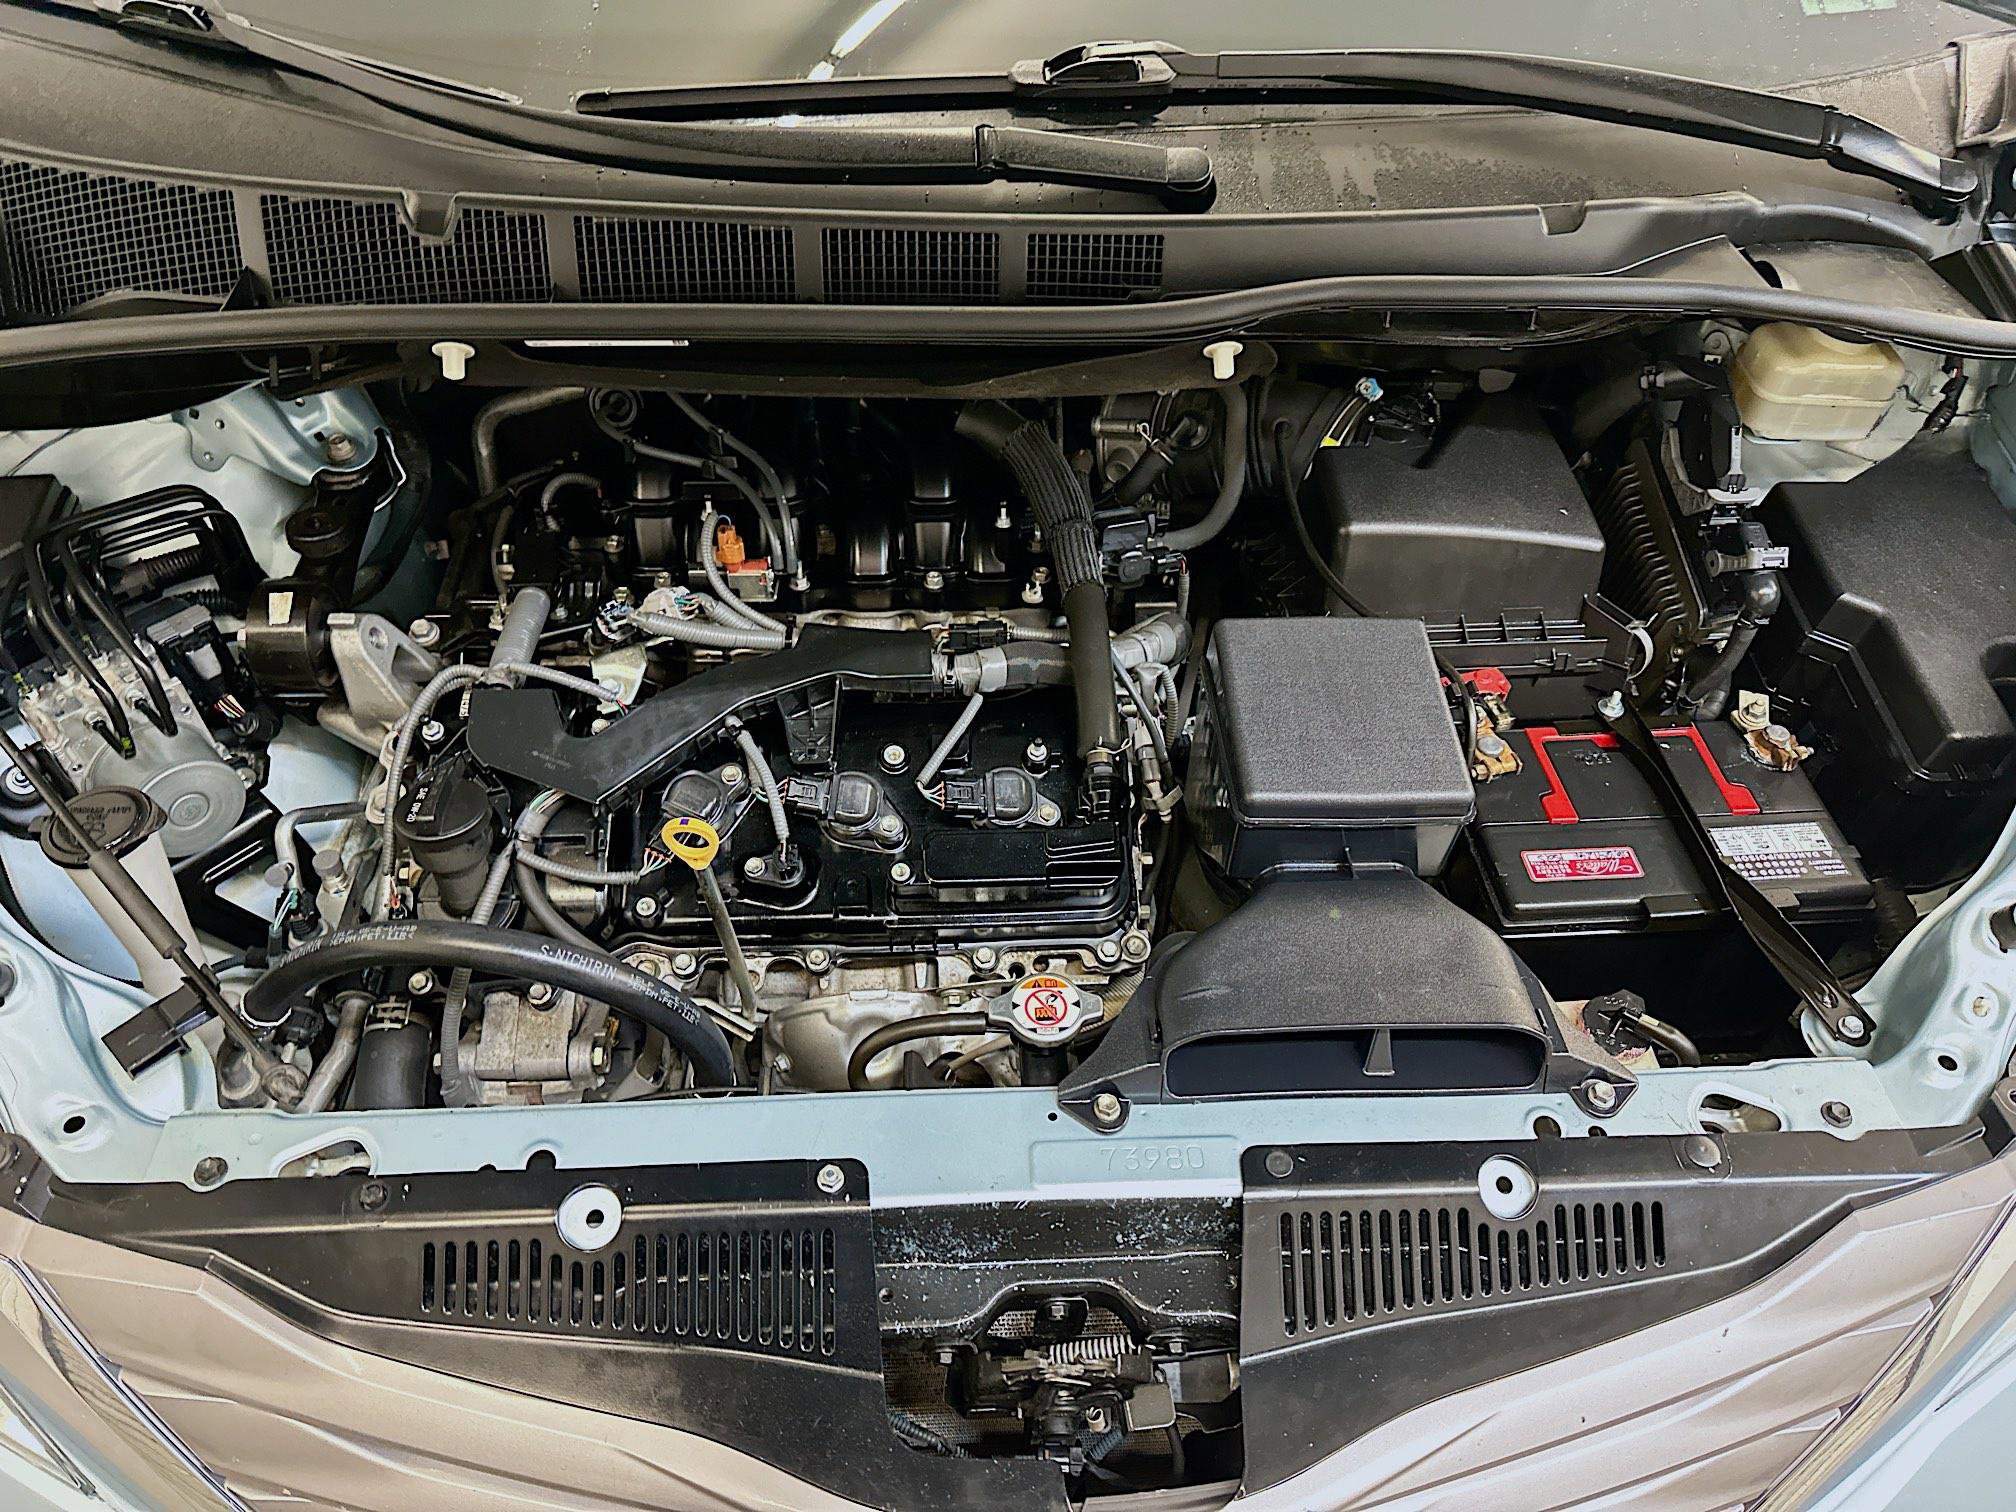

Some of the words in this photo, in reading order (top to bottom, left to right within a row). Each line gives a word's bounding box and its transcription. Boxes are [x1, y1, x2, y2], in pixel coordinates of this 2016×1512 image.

[416, 787, 428, 800] SAE
[406, 802, 421, 822] 0W-20
[1100, 1146, 1205, 1171] 73980
